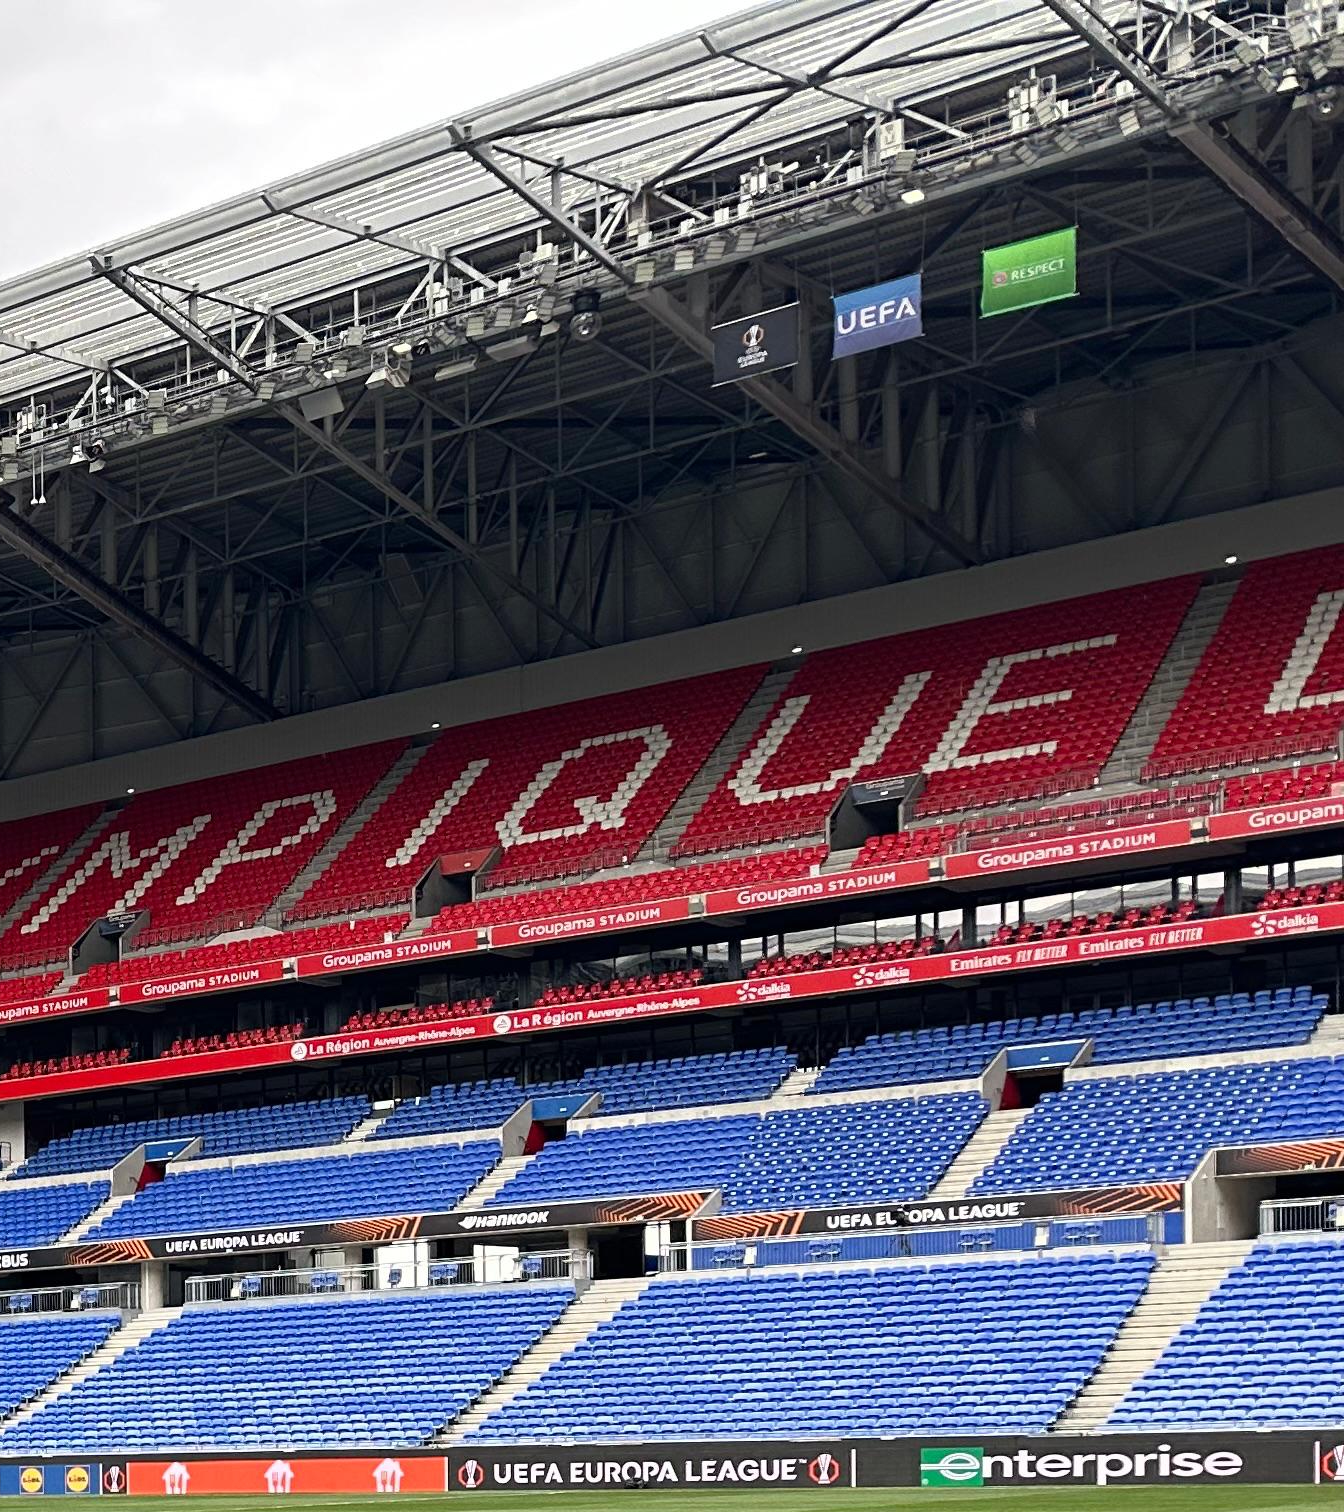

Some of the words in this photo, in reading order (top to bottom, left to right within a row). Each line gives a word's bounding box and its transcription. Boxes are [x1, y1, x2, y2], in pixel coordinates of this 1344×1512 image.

[1011, 258, 1065, 281] RESPECT
[837, 297, 917, 335] UEFA
[977, 843, 1074, 870] Groupama
[1079, 832, 1156, 854] STADIUM
[737, 883, 823, 905] Groupama
[828, 872, 896, 892] STADIUM
[518, 916, 595, 939] Groupama
[599, 907, 660, 926] STADIUM
[1277, 913, 1318, 929] dalkia
[322, 948, 392, 969] Groupama
[397, 939, 452, 957] STADIUM
[1078, 935, 1144, 955] Emirates
[950, 953, 1012, 972] Emirates
[141, 977, 205, 997] Groupama
[209, 969, 260, 986] STADIUM
[42, 997, 88, 1014] STADIUM
[513, 1014, 529, 1029] La
[531, 1009, 583, 1030] Région
[309, 1041, 324, 1056] La
[325, 1036, 370, 1056] Région
[826, 1213, 873, 1229] UEFA
[166, 1240, 198, 1253] UEFA
[200, 1236, 250, 1252] EUROPA
[493, 1463, 563, 1484] UEFA
[570, 1461, 679, 1483] EUROPA
[921, 1444, 1244, 1486] enterprise
